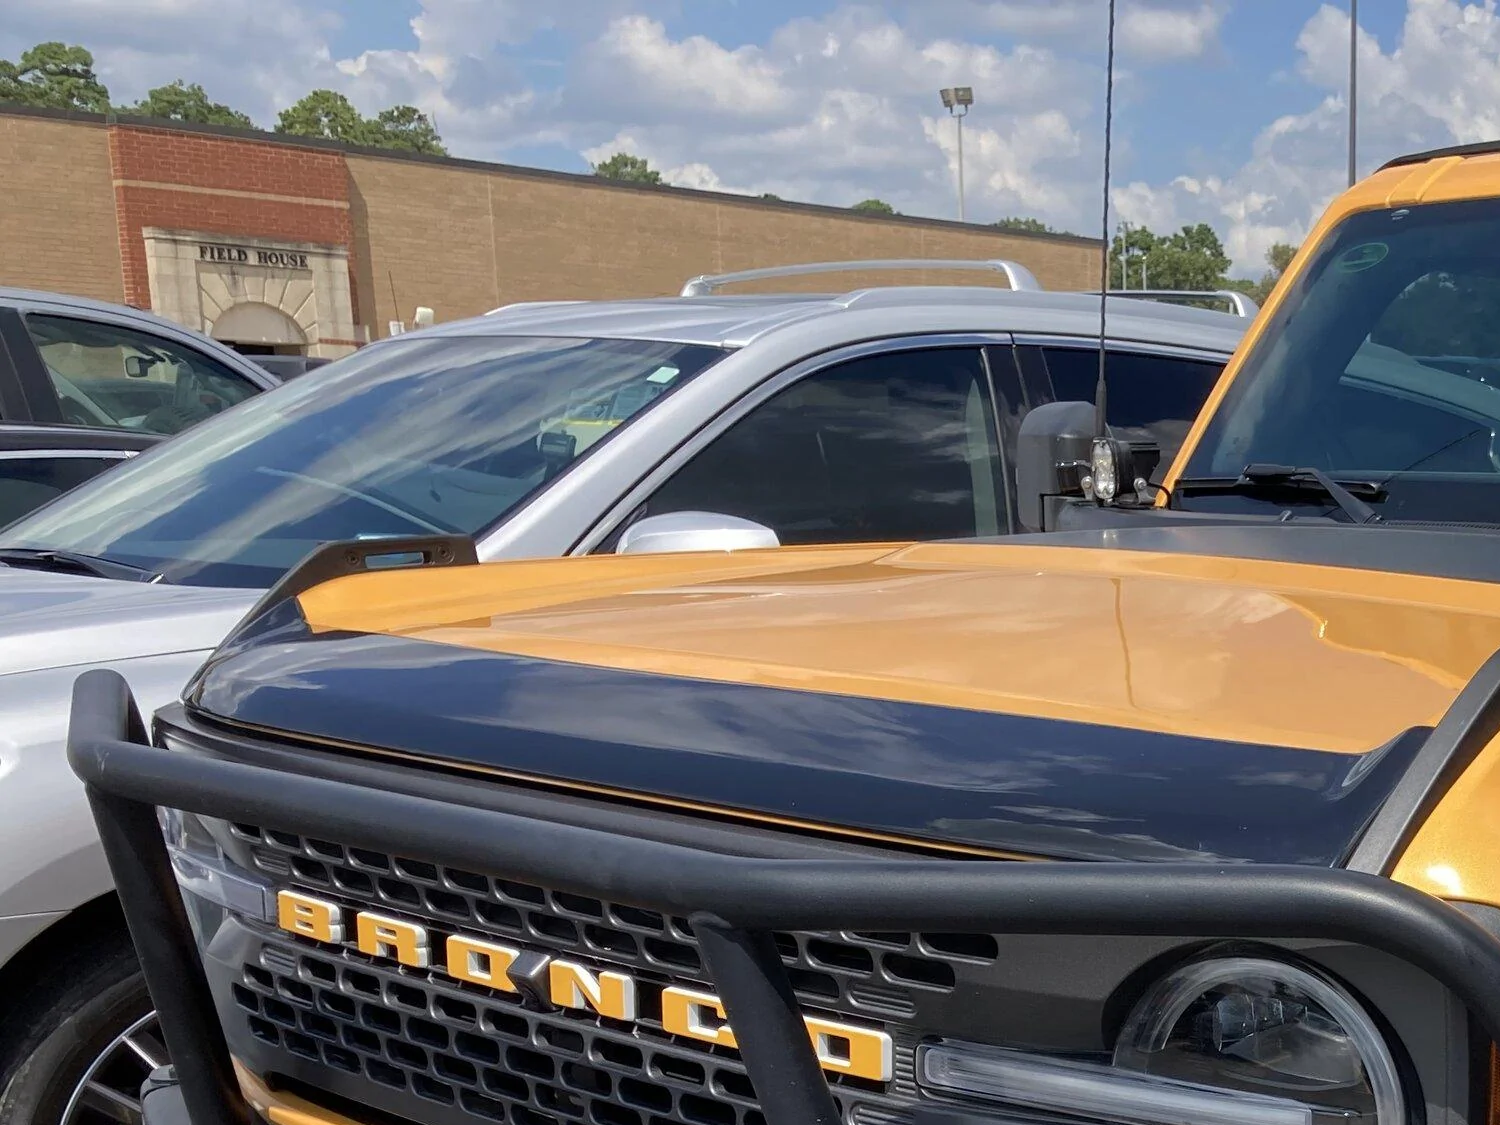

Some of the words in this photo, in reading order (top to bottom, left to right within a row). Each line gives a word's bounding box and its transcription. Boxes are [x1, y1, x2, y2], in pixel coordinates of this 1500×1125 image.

[200, 244, 248, 261] FIELD
[257, 251, 308, 268] HOUSE
[278, 889, 893, 1082] BRONCO
